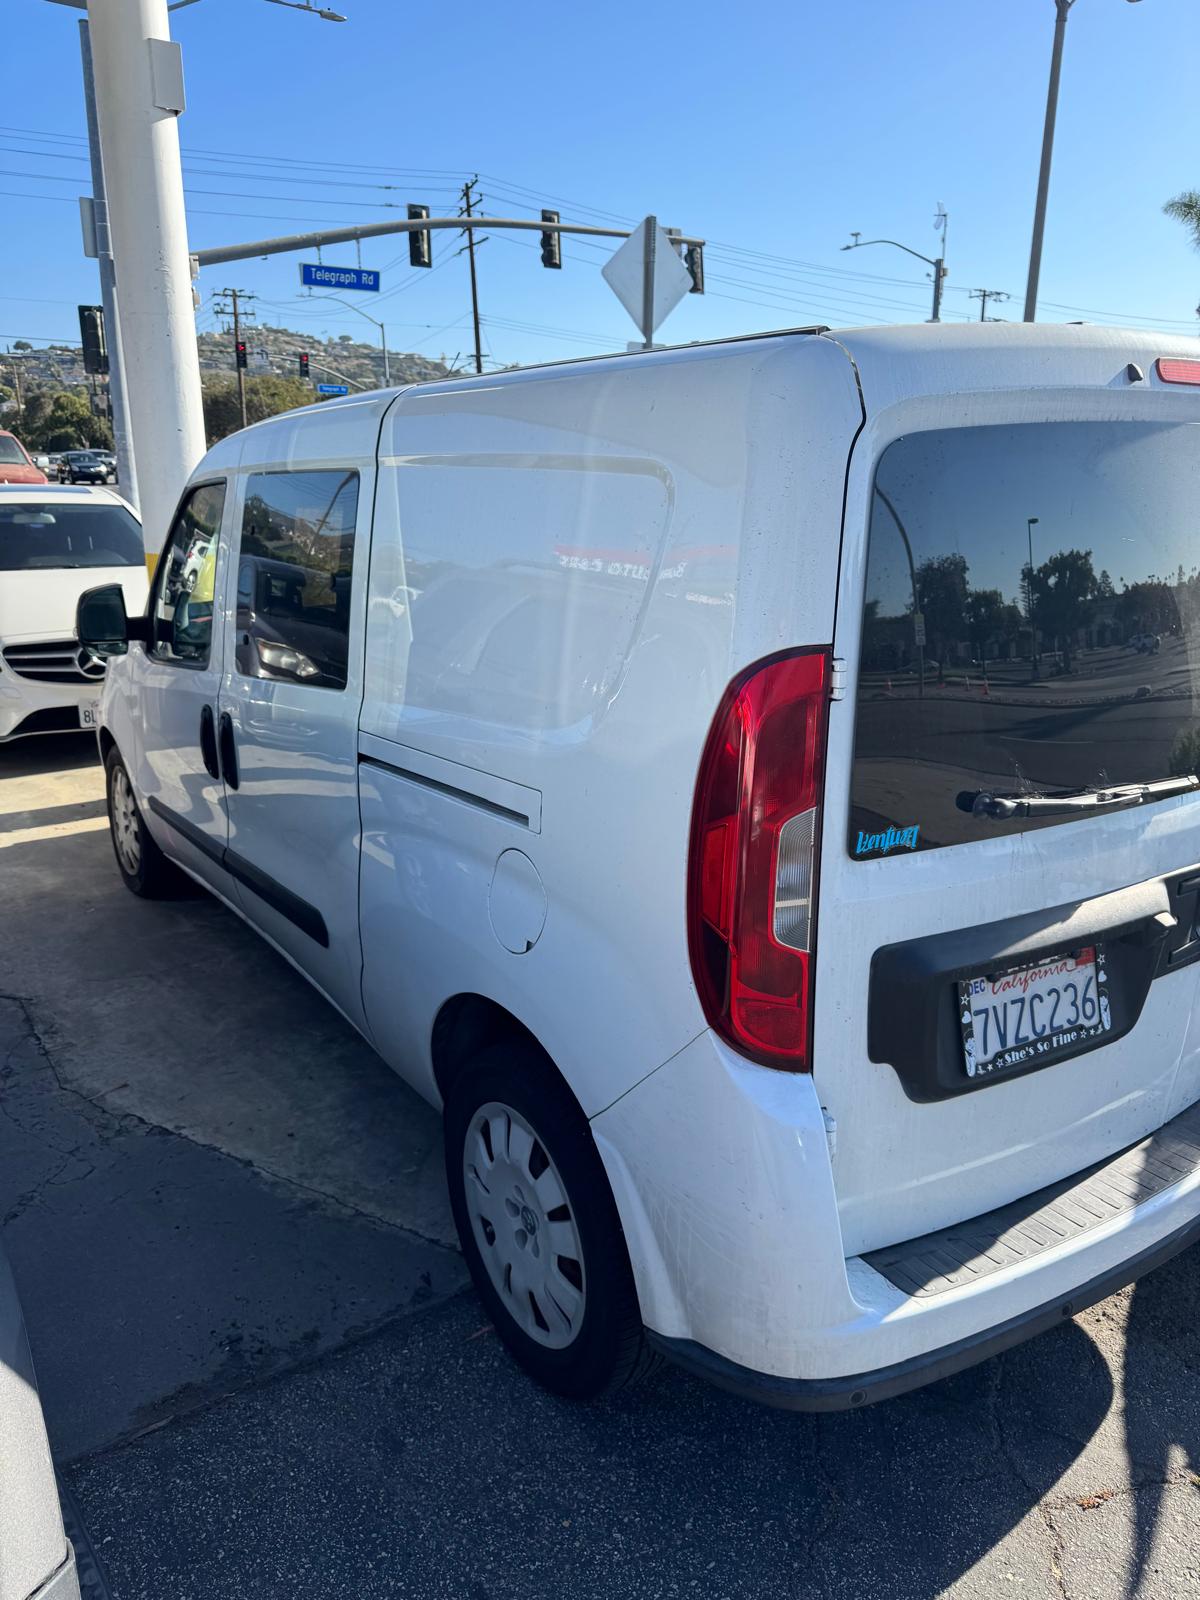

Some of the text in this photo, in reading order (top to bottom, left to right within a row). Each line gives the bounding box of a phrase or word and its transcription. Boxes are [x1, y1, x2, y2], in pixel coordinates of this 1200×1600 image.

[311, 268, 374, 285] Telegraph Rd
[969, 979, 986, 996] DEC
[991, 960, 1076, 995] California
[973, 975, 1096, 1056] 7VZC236
[1004, 1030, 1078, 1064] She's So Fine
